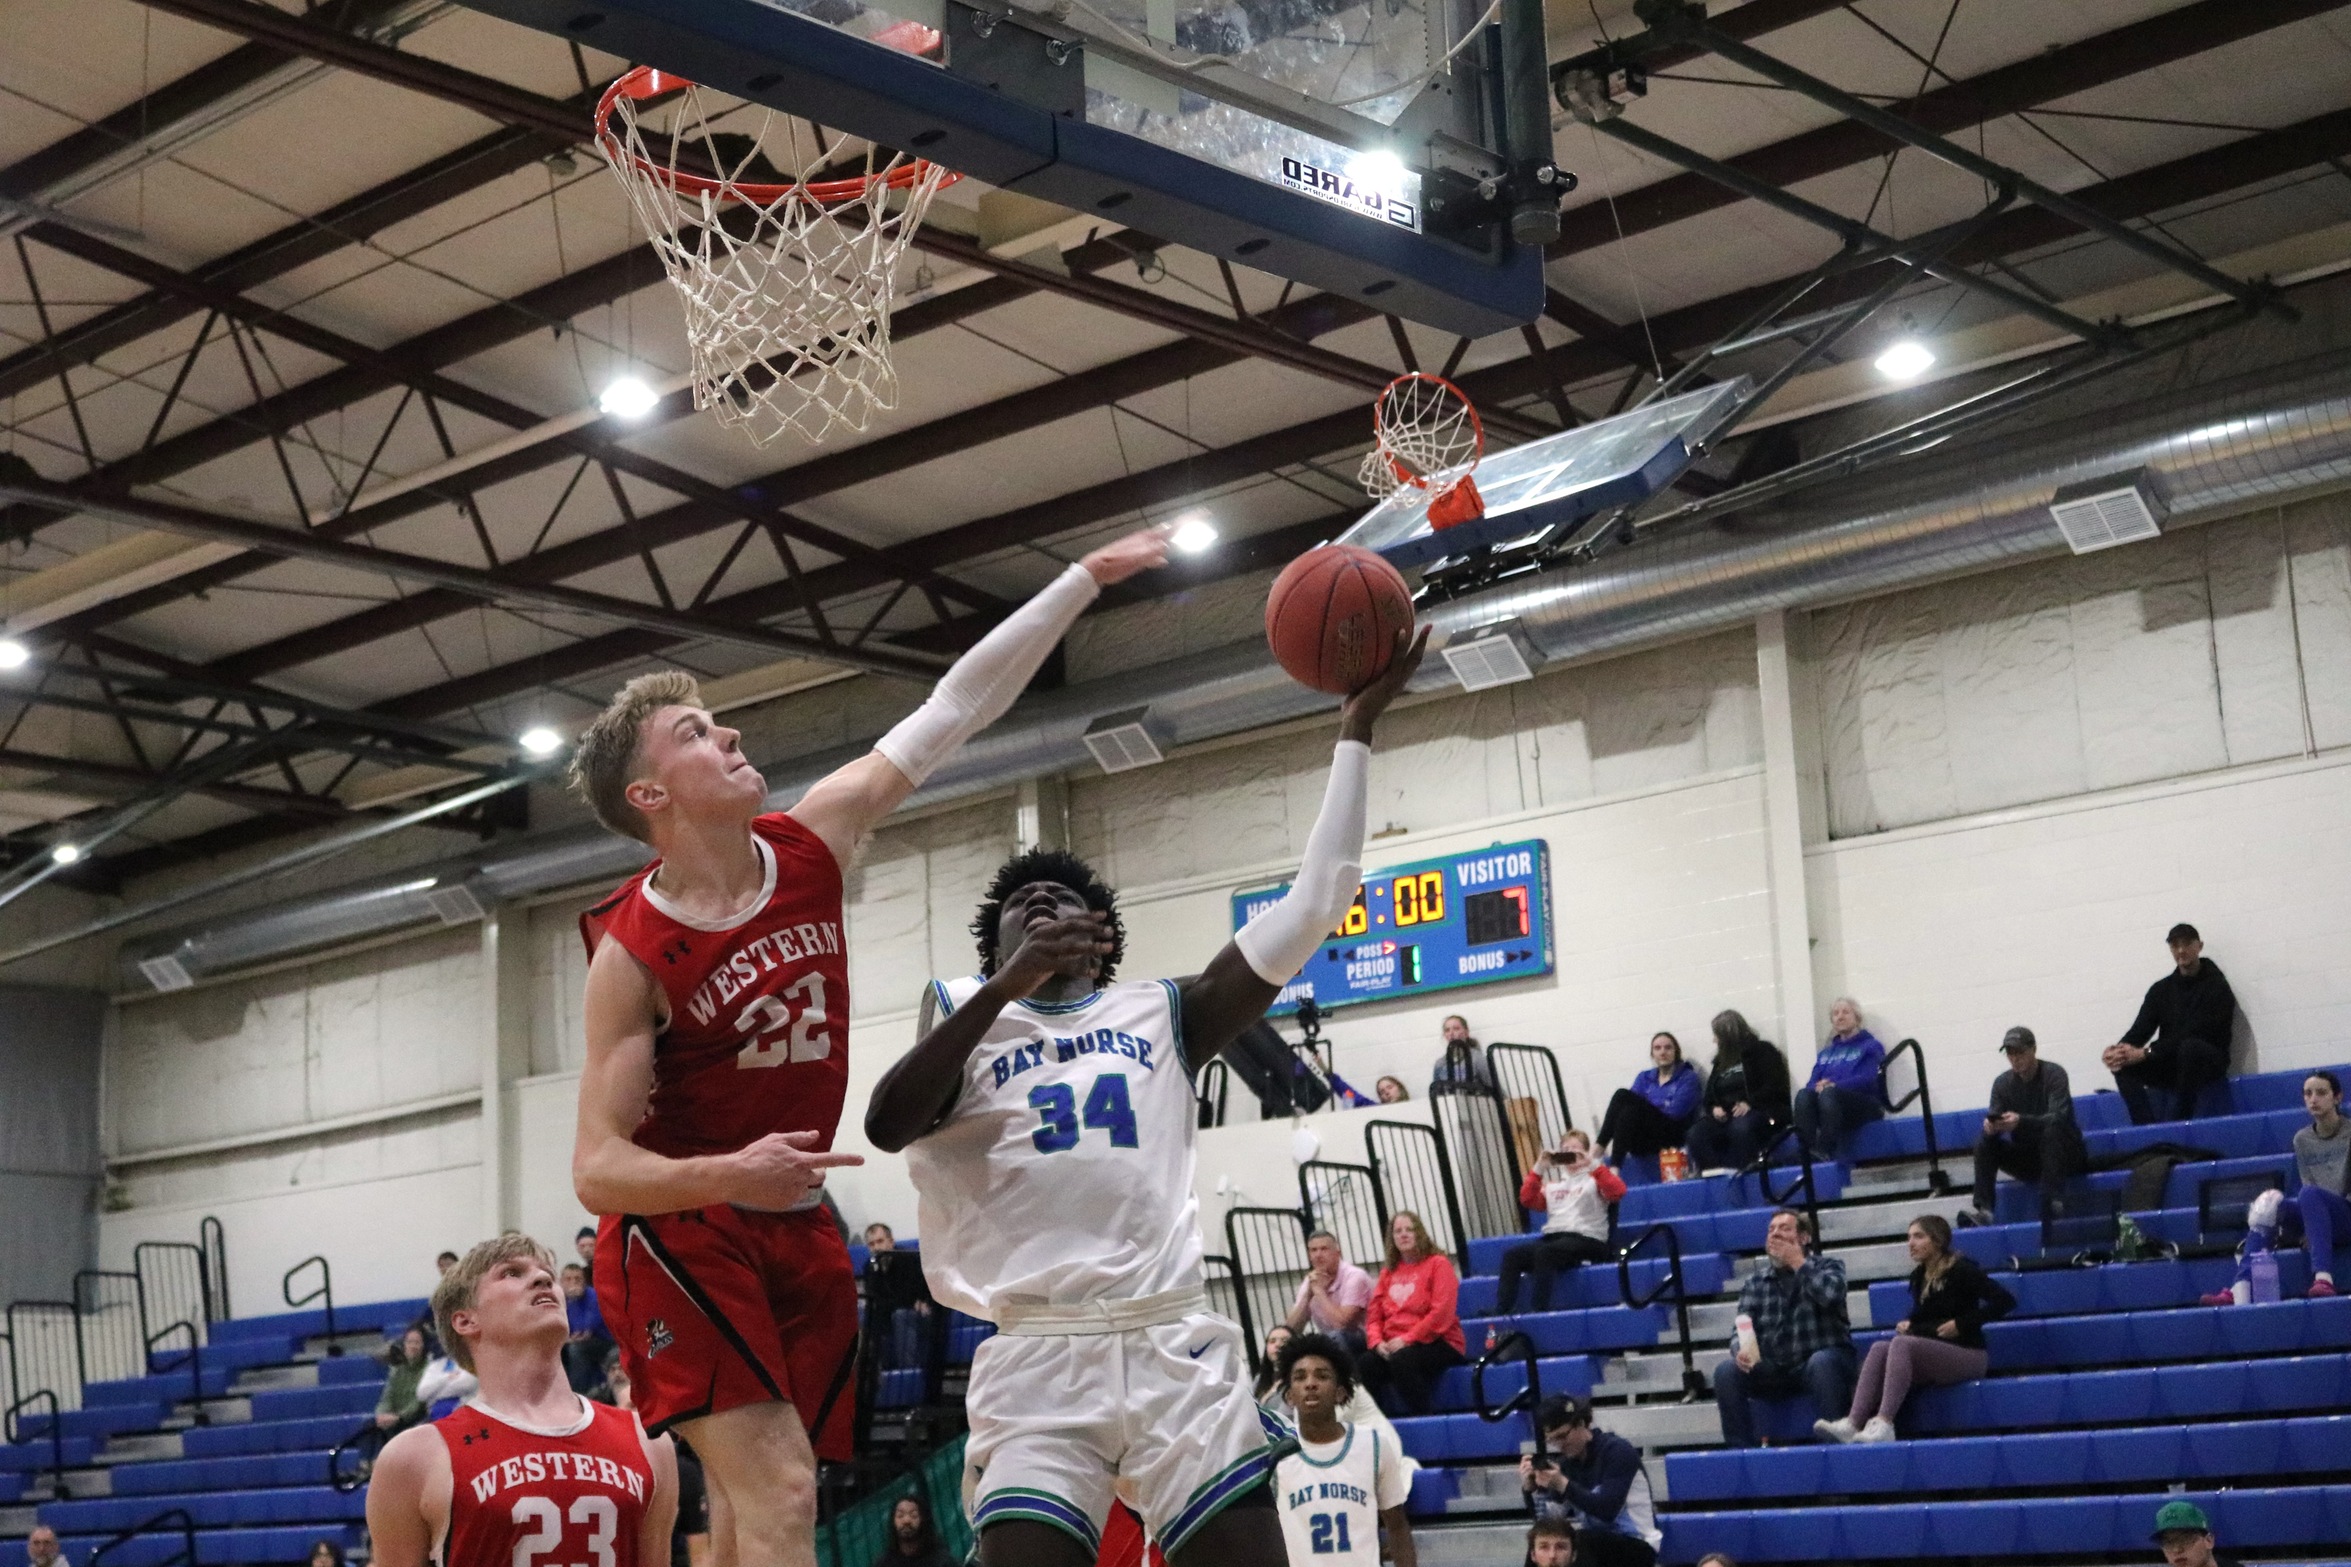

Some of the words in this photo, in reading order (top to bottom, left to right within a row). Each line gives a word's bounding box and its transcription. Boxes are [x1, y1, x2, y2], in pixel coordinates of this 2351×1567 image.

[1457, 852, 1531, 887] VISITOR
[1503, 887, 1530, 936] 7
[686, 921, 839, 1027] WESTERN
[1346, 957, 1395, 981] PERIOD
[1356, 943, 1382, 960] POSS
[1458, 951, 1505, 975] BONUS
[734, 971, 831, 1070] 22
[991, 1039, 1044, 1090] BAY
[1027, 1073, 1139, 1155] 34
[470, 1452, 644, 1504] WESTERN
[1289, 1485, 1314, 1511] BAY
[1319, 1482, 1368, 1507] NORSE
[511, 1495, 618, 1567] 23
[1310, 1512, 1352, 1554] 21
